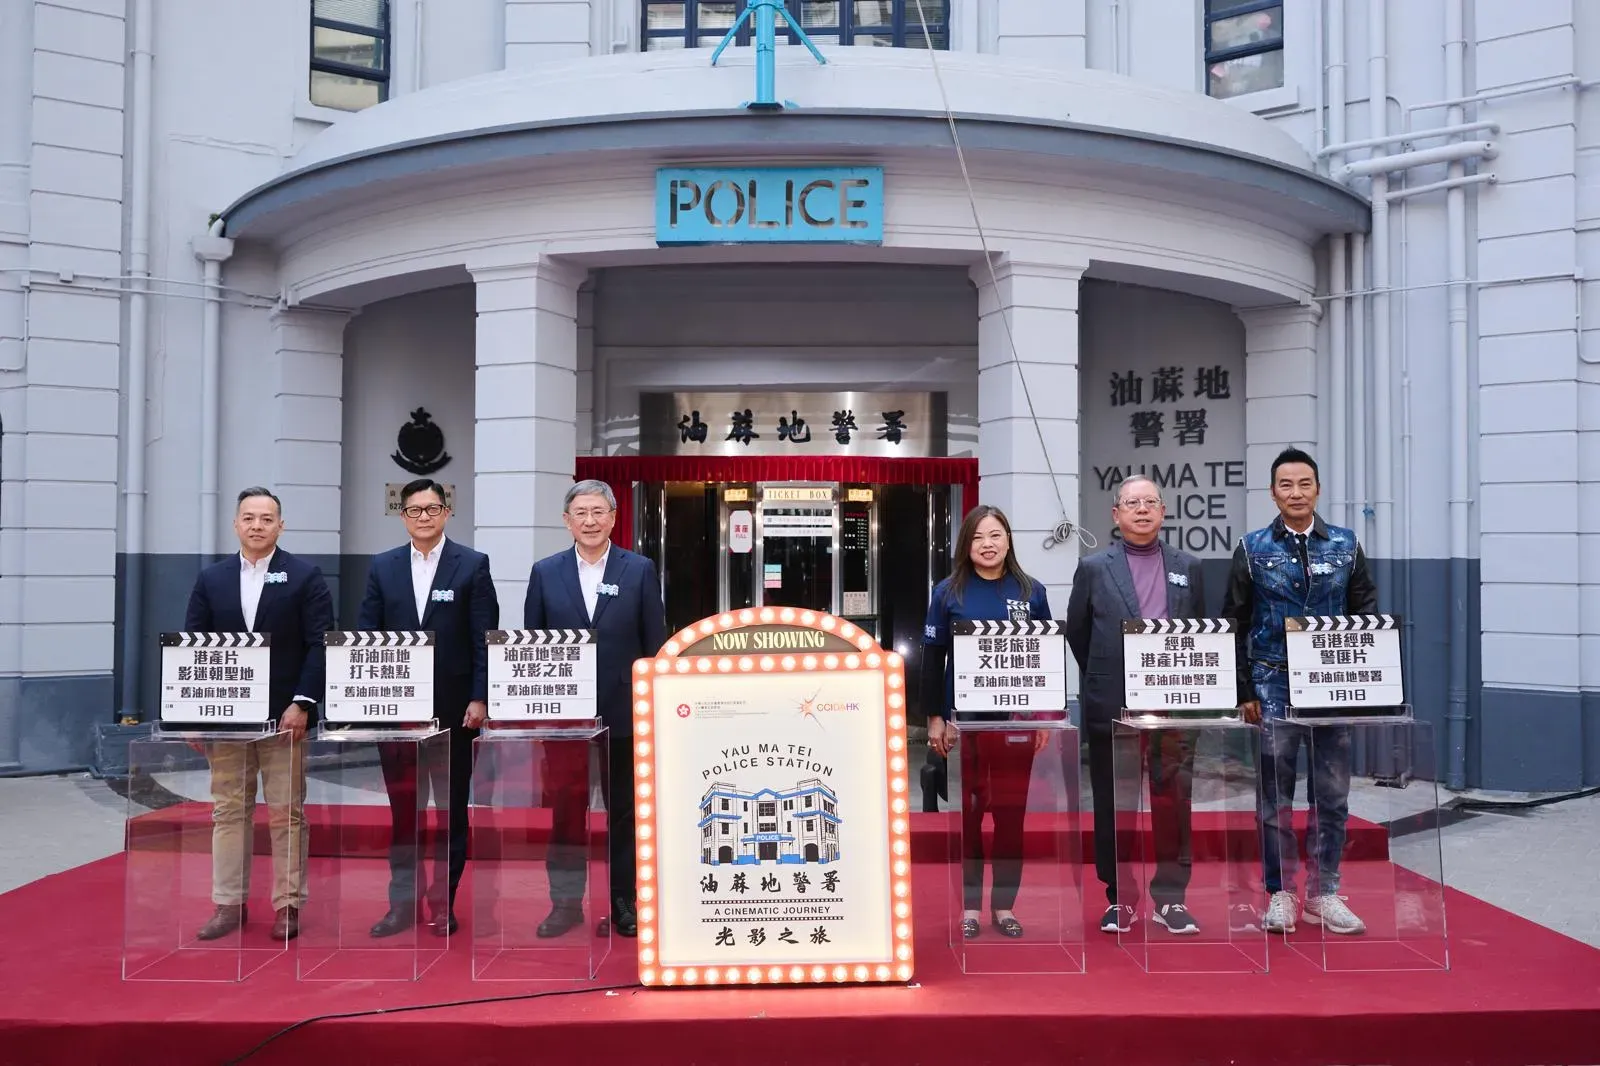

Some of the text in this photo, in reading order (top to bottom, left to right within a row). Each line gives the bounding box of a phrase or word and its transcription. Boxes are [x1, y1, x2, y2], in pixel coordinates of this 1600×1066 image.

[670, 179, 869, 228] POLICE
[1109, 365, 1231, 407] 油蔴地
[1130, 408, 1209, 448] 警署
[1151, 462, 1199, 489] MA
[768, 489, 828, 499] TICKET BOX
[713, 630, 825, 650] NOW SHOWING
[978, 638, 1040, 653] 電影旅遊
[1164, 636, 1196, 651] 經典
[1312, 632, 1375, 649] 香港經典
[194, 650, 239, 665] 港產片
[349, 648, 410, 664] 新油麻地
[978, 654, 1041, 669] 文化地標
[1141, 652, 1220, 668] 港產片場景
[1320, 649, 1368, 665] 警匪片
[178, 666, 254, 681] 影迷朝聖地
[349, 664, 410, 680] 打卡熱點
[512, 662, 573, 678] 光影之旅
[992, 694, 1029, 706] 1月1日
[1163, 692, 1201, 704] 1月1日
[1328, 689, 1366, 701] 1月1日
[198, 704, 234, 717] 1月1日
[362, 704, 398, 716] 1月1日
[525, 702, 561, 714] 1月1日
[721, 743, 812, 759] YAU MA TEI
[702, 756, 833, 780] POLICE STATION
[714, 906, 831, 916] A CINEMATIC JOURNEY
[714, 925, 832, 947] 光影之旅
